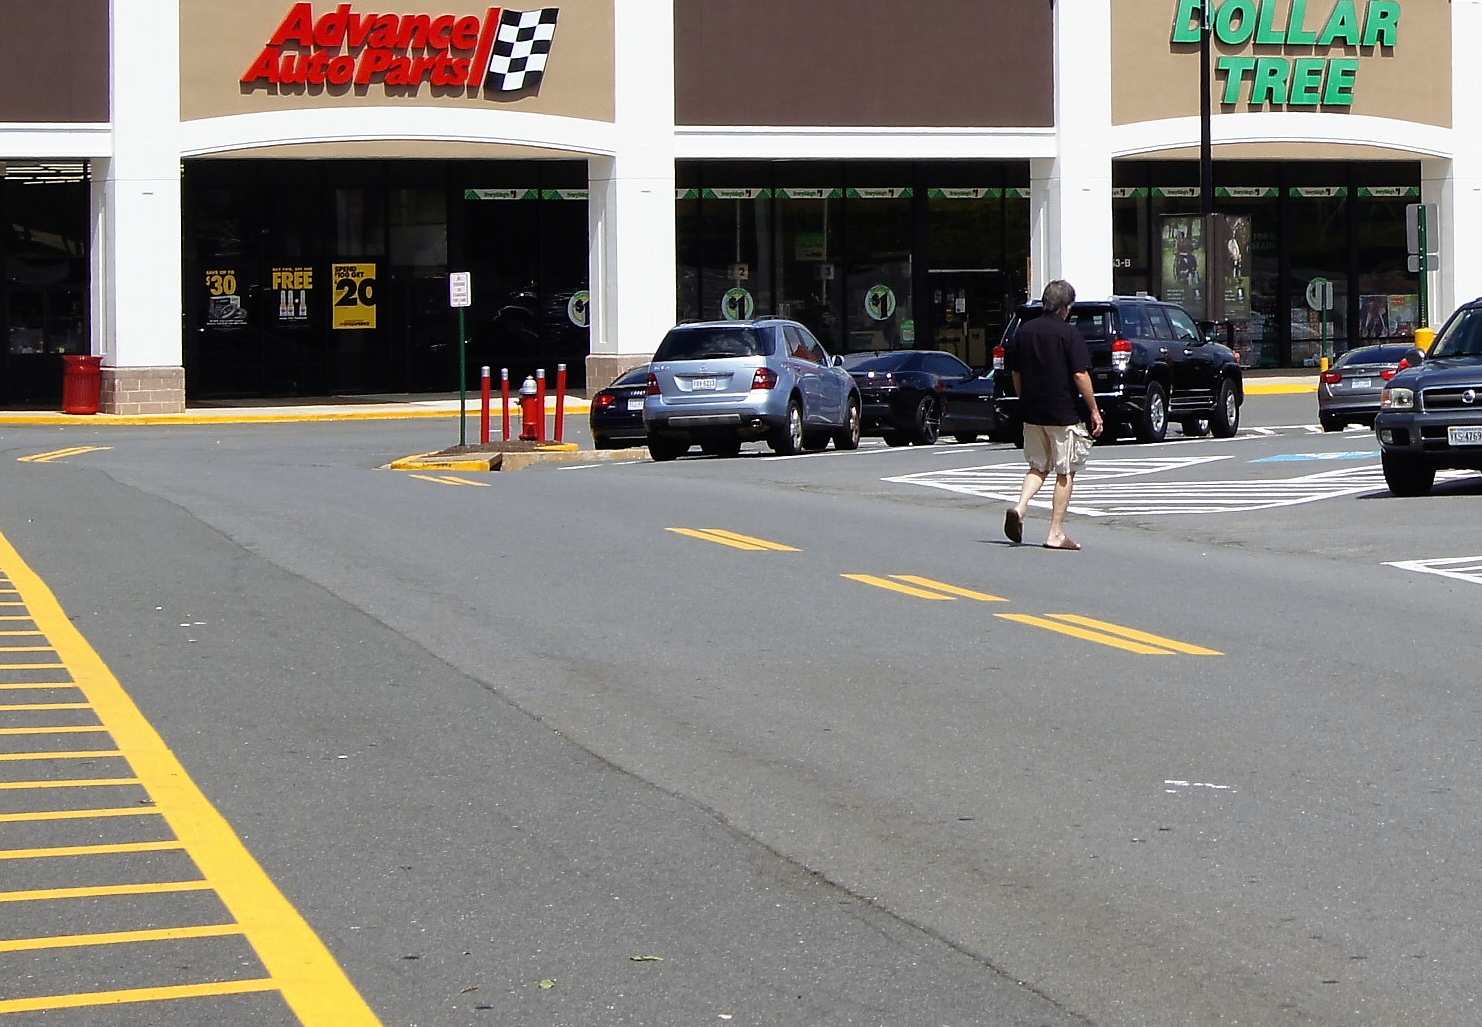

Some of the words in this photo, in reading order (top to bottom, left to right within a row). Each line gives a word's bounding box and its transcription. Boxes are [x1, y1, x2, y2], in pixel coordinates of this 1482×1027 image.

[266, 1, 481, 50] Advance
[240, 45, 355, 84] Auto
[354, 47, 471, 86] Parts
[1217, 55, 1360, 106] TREE
[206, 274, 236, 295] $30
[272, 272, 312, 290] FREE
[872, 293, 888, 318] $1
